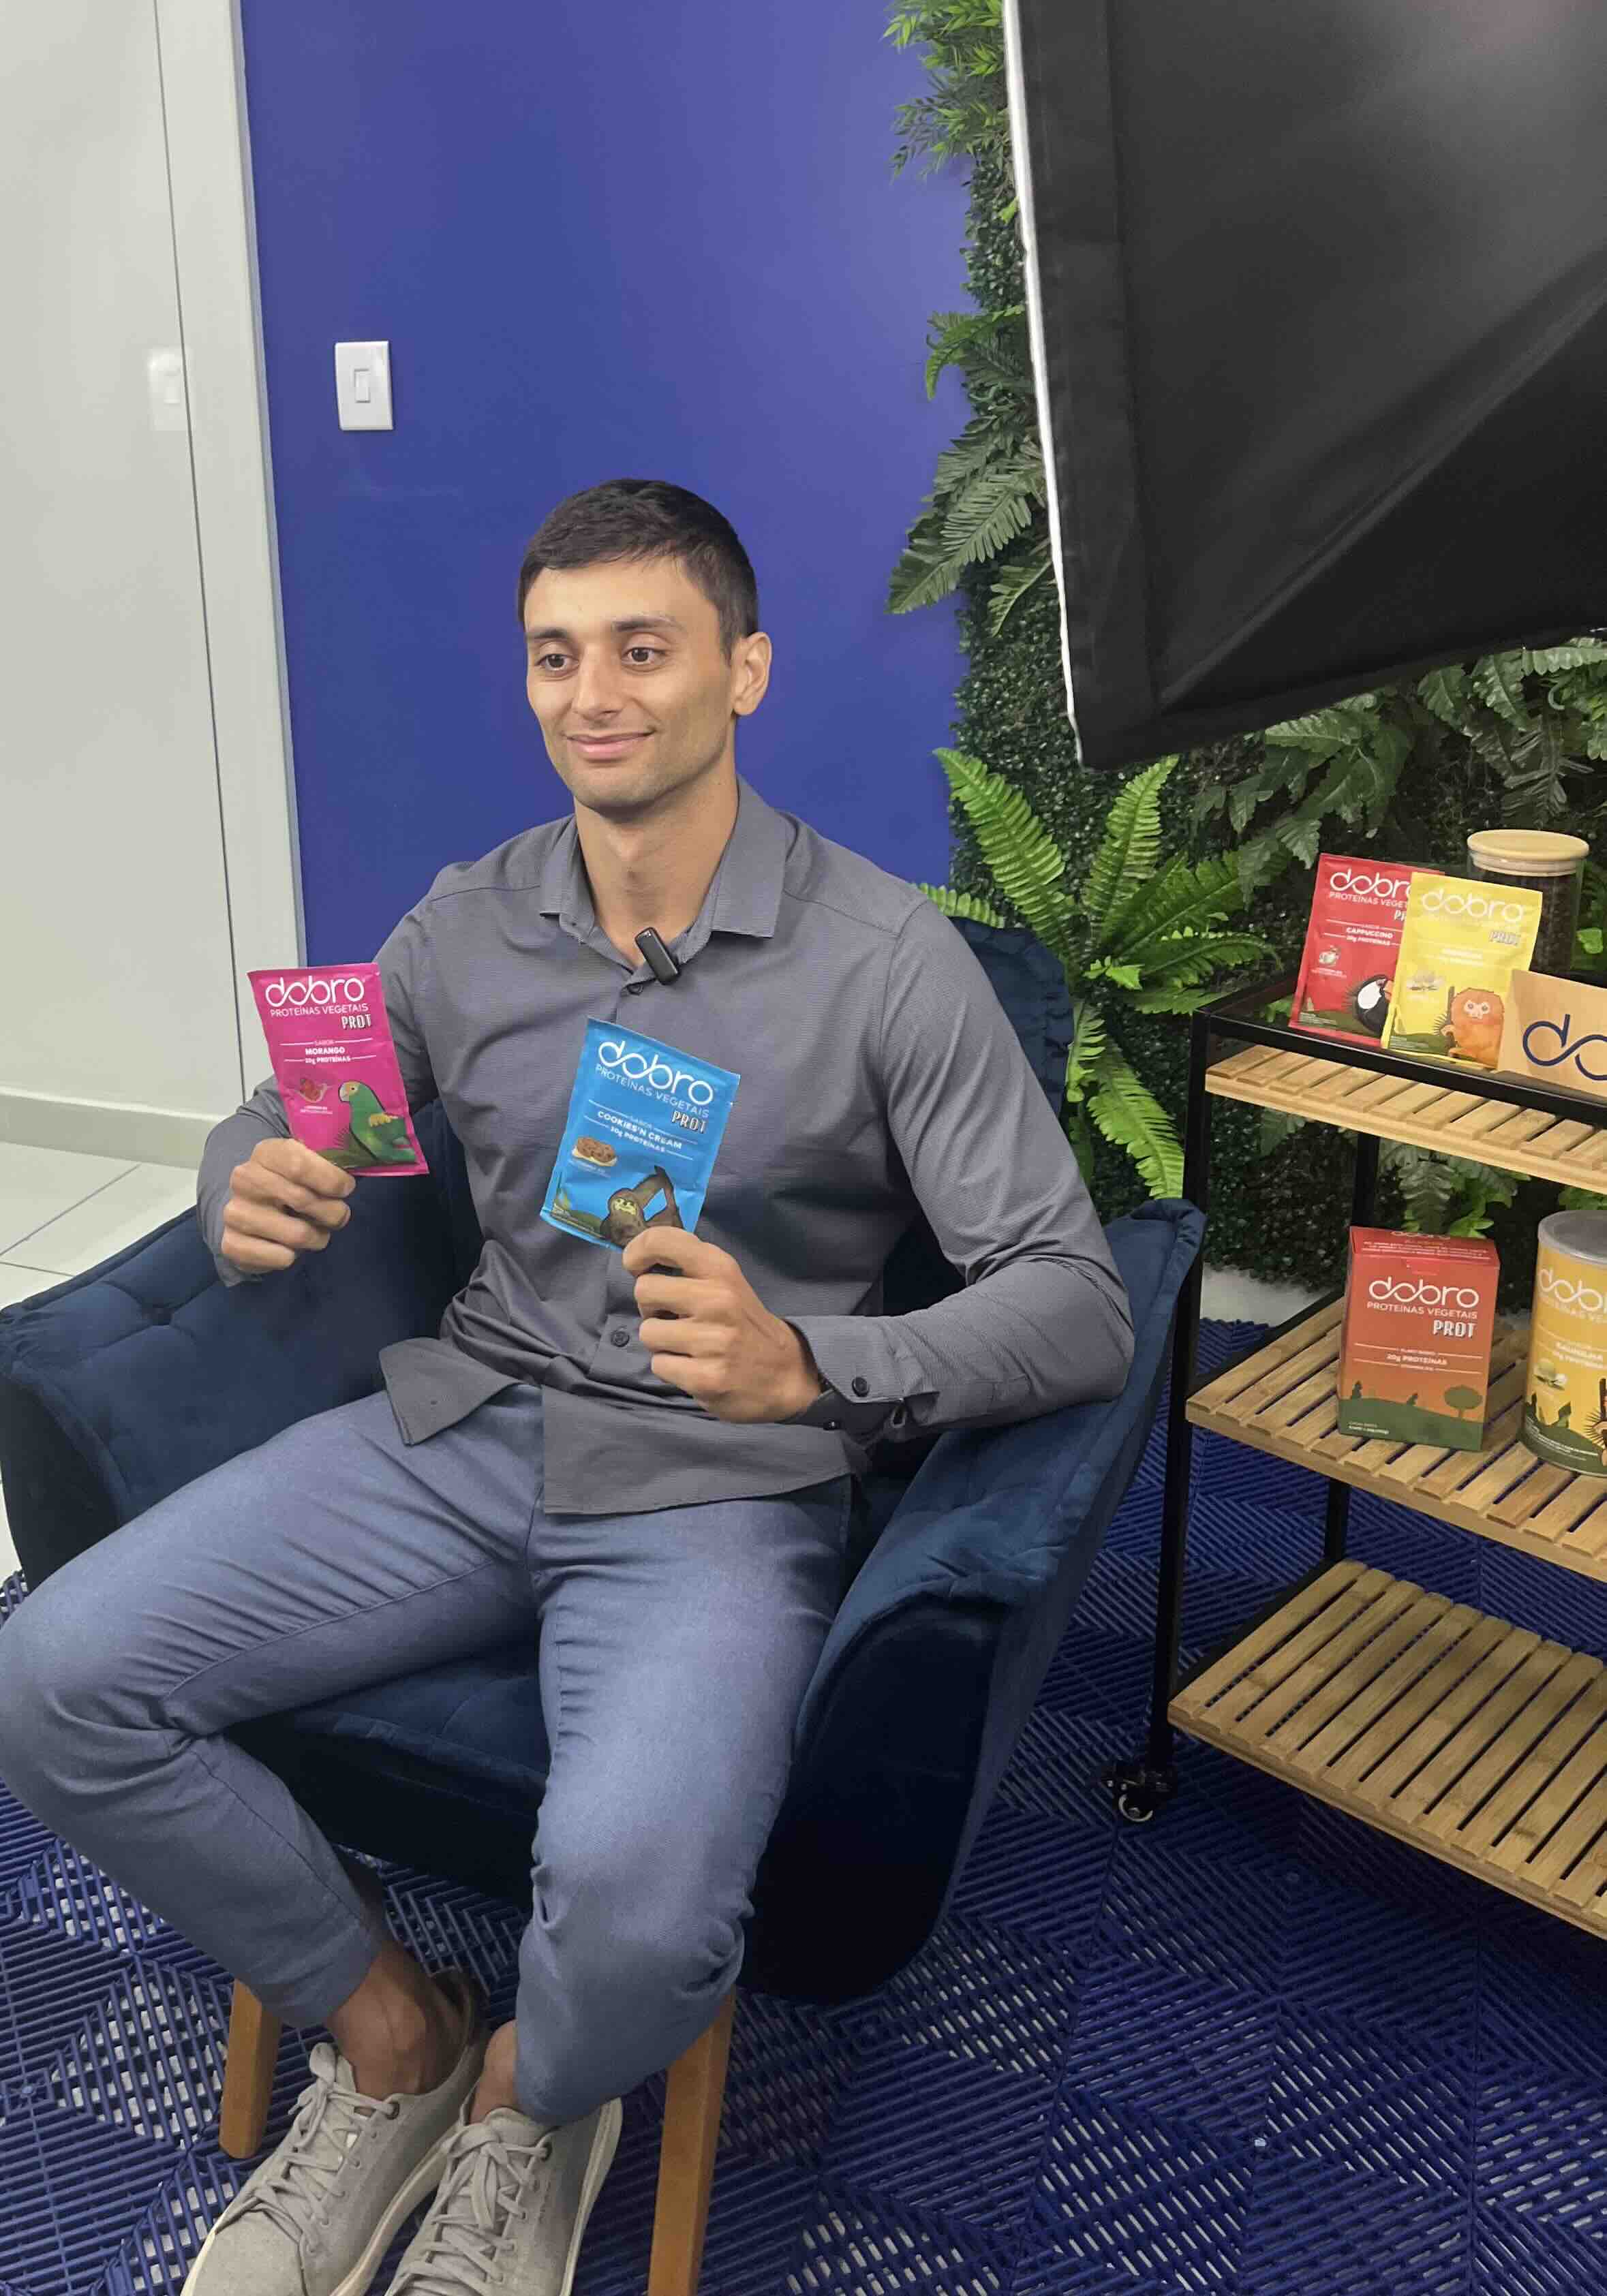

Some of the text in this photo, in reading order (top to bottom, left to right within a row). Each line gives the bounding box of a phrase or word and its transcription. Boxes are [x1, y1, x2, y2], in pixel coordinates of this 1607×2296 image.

[1330, 869, 1411, 898] dobr
[1422, 888, 1524, 922] dobro
[1346, 927, 1393, 939] CAPPUCCINO
[265, 976, 365, 1007] dobro
[323, 1003, 369, 1014] VEGETAIS
[341, 1014, 371, 1029] PROT
[305, 1046, 346, 1055] MORANGO
[598, 1040, 714, 1105] dobro
[655, 1093, 709, 1118] VEGETAIS
[671, 1110, 707, 1134] PROT
[648, 1132, 682, 1149] CREAM
[1368, 1276, 1480, 1309] dobro
[1427, 1307, 1478, 1320] VEGETAIS
[1433, 1319, 1478, 1338] PROT
